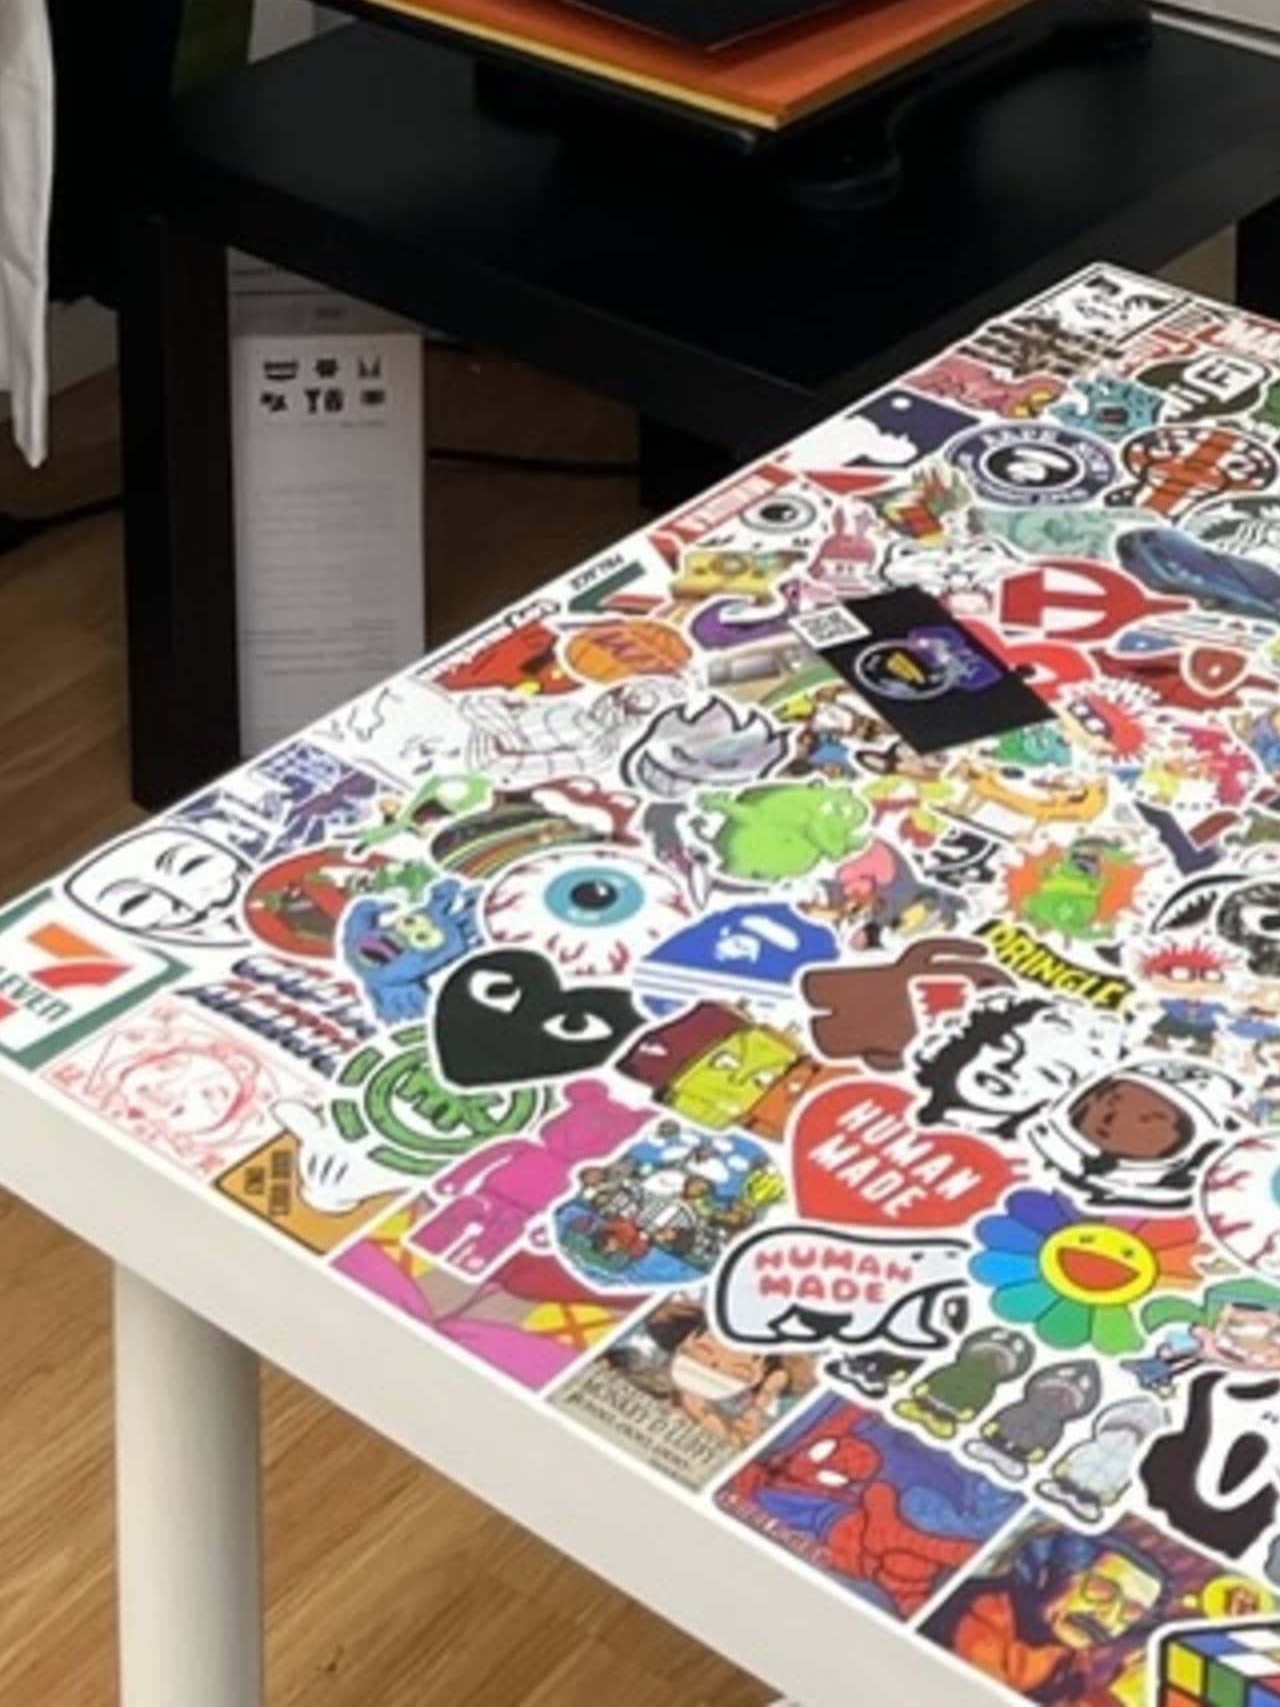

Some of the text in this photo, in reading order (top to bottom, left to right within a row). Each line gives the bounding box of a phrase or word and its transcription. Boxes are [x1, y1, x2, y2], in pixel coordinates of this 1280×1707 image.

[807, 1133, 929, 1219] MADE
[835, 1098, 983, 1201] HUMAN
[754, 1245, 912, 1284] HUMAN
[758, 1274, 886, 1304] MADE
